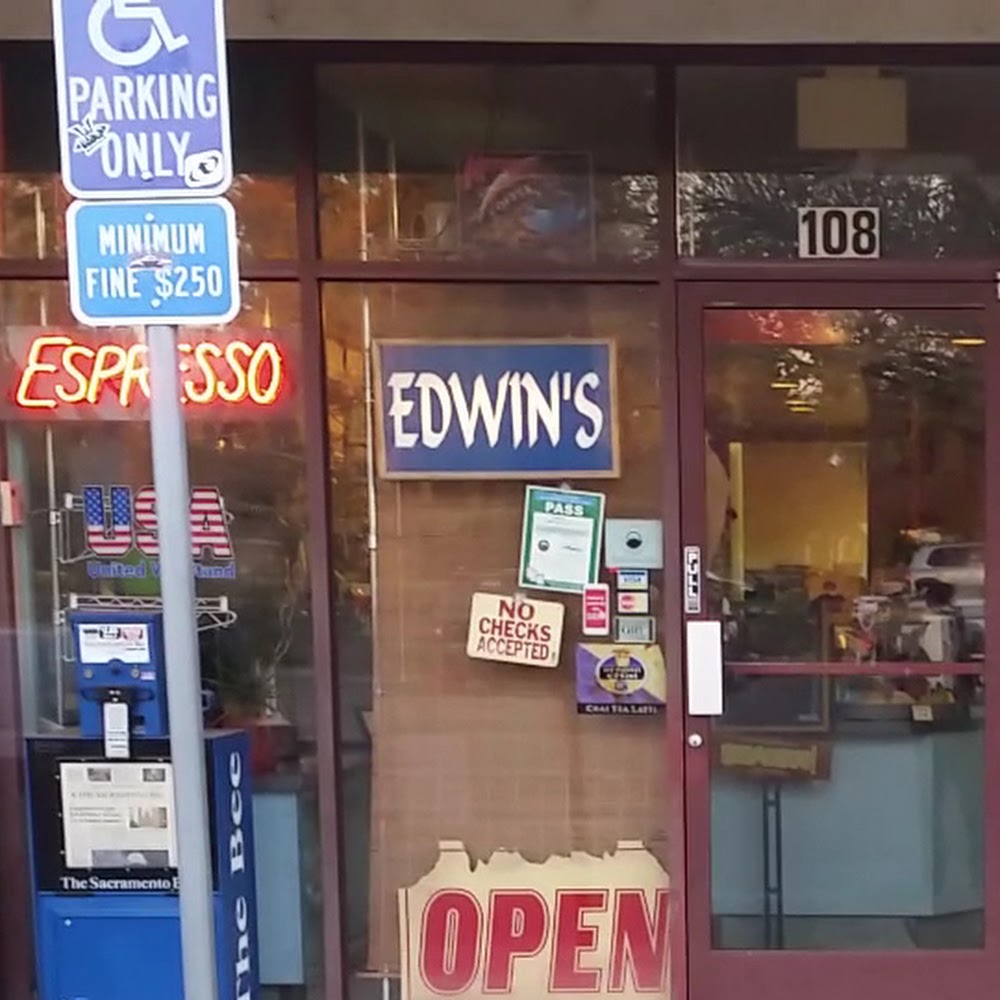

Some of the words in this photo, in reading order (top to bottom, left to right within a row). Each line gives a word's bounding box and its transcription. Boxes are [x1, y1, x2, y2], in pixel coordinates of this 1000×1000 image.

[68, 73, 218, 121] PARKING
[102, 131, 191, 178] ONLY
[99, 223, 206, 256] MINIMUM
[801, 210, 877, 256] 108
[86, 267, 141, 298] FINE
[155, 265, 222, 299] $250
[16, 336, 282, 408] ESPRSSO
[387, 371, 603, 449] EDWIN'S
[544, 501, 584, 516] PASS
[478, 617, 552, 642] CHECKS
[499, 600, 535, 621] NO
[477, 635, 550, 660] ACCEPTED
[229, 751, 245, 875] Bee
[60, 876, 87, 890] The
[89, 876, 171, 890] Sacramento
[419, 887, 671, 995] OPEN
